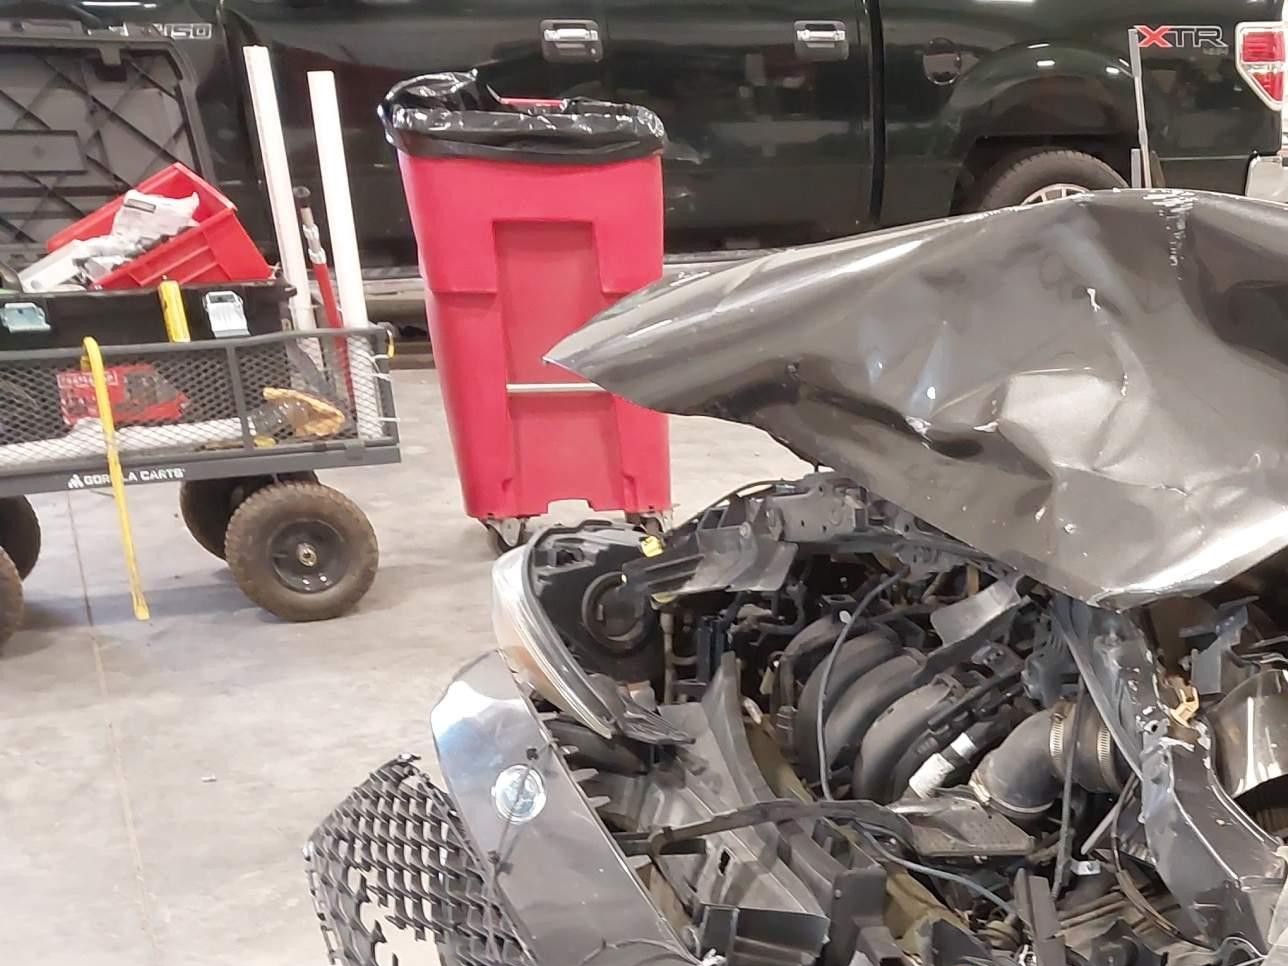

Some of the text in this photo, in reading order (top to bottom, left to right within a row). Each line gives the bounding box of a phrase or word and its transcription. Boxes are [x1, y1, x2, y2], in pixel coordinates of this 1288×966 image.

[1133, 25, 1229, 48] XTR
[83, 467, 184, 486] GORA CARTS
